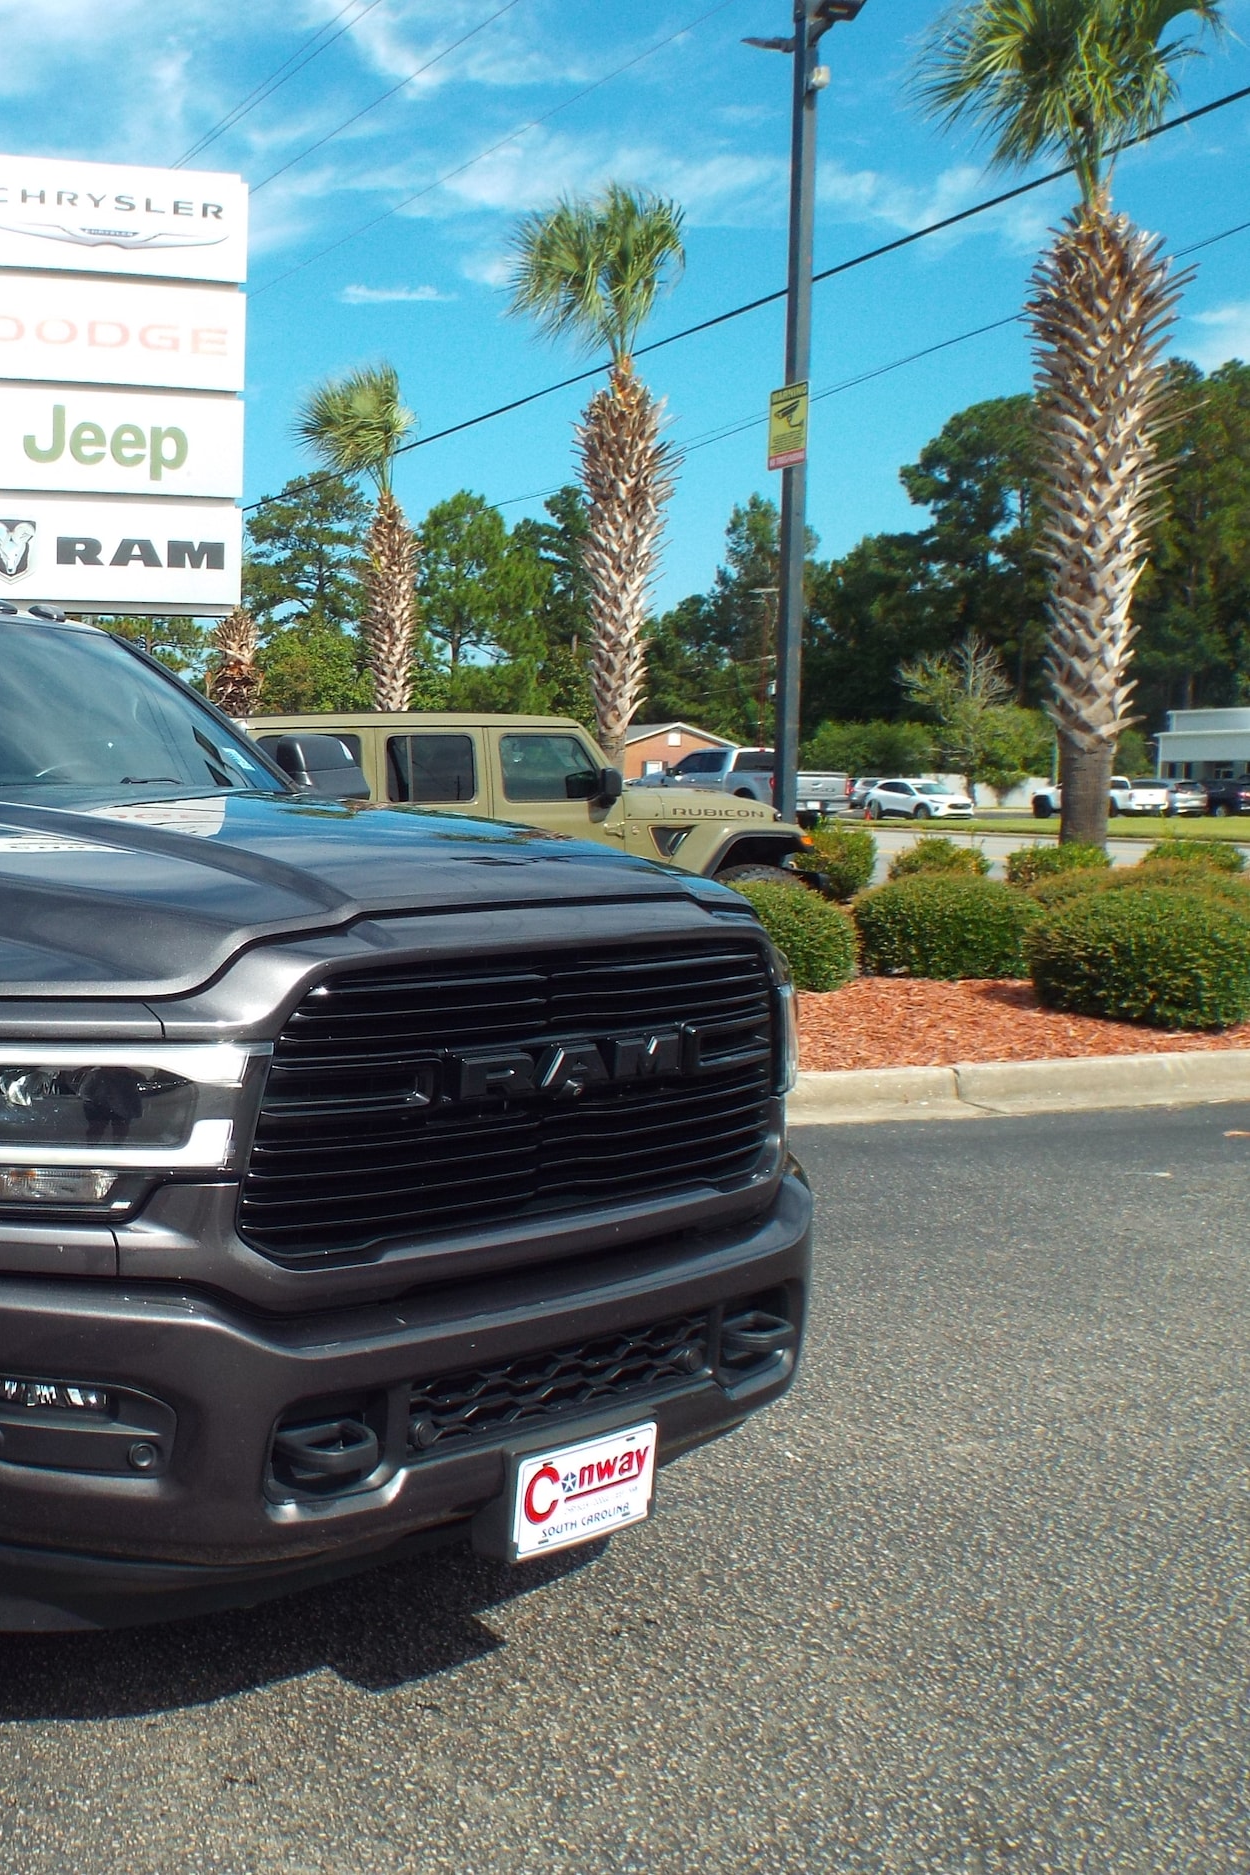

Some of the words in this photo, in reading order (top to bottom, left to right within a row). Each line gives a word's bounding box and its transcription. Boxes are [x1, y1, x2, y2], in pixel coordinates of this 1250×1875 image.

[23, 404, 188, 481] Jeep
[56, 536, 225, 570] RAM
[672, 807, 765, 819] RUBICON
[460, 1032, 681, 1100] RAM
[541, 1519, 578, 1539] SOUTH
[580, 1501, 630, 1527] CAROLINA
